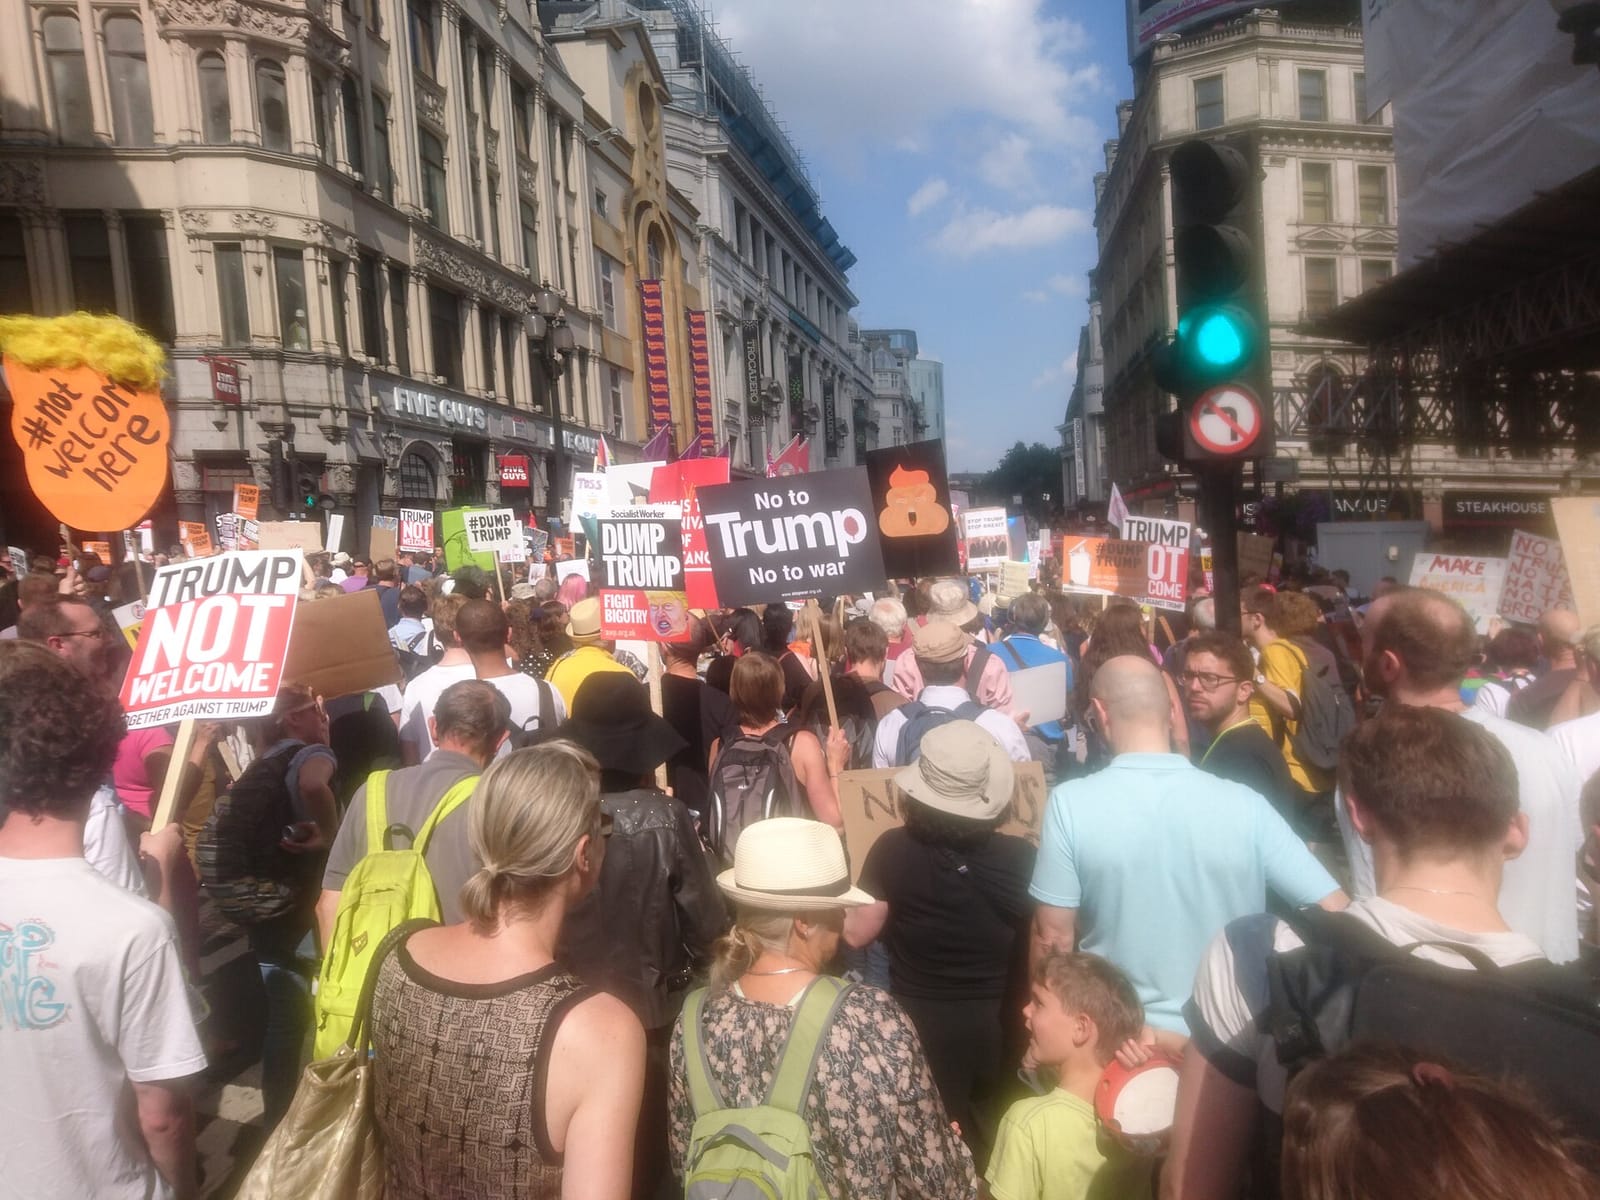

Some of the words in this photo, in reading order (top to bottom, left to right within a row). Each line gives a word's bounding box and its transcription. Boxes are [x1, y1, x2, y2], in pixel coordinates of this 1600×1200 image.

[394, 387, 439, 419] FIVE
[439, 399, 486, 430] GUYS
[82, 415, 160, 492] here
[754, 492, 783, 510] No
[788, 490, 810, 505] to
[1456, 501, 1546, 514] STEAKHOUSE
[401, 510, 432, 524] TRUMP
[469, 514, 511, 529] #DUMP
[403, 521, 432, 540] NOT
[472, 528, 512, 543] TRUMP
[602, 523, 665, 555] DUMP
[705, 508, 867, 558] Trump
[1125, 519, 1188, 547] TRUMP
[402, 538, 431, 547] WELCOME
[1096, 543, 1144, 556] #DUMP
[1516, 534, 1549, 556] NO
[602, 555, 681, 588] TRUMP
[1096, 555, 1142, 568] TRUMP
[1147, 544, 1184, 583] OT
[1429, 555, 1487, 576] MAKE
[158, 556, 296, 609] TRUMP
[749, 567, 777, 585] No
[782, 565, 804, 581] to
[808, 561, 846, 577] war
[1148, 580, 1182, 599] COME
[604, 594, 635, 609] FIGHT
[604, 609, 648, 625] BIGOTRY
[138, 594, 286, 676] NOT
[128, 662, 274, 707] WELCOME
[125, 708, 169, 727] OGETHER
[173, 702, 221, 717] AGAINST
[226, 700, 268, 714] TRUMP
